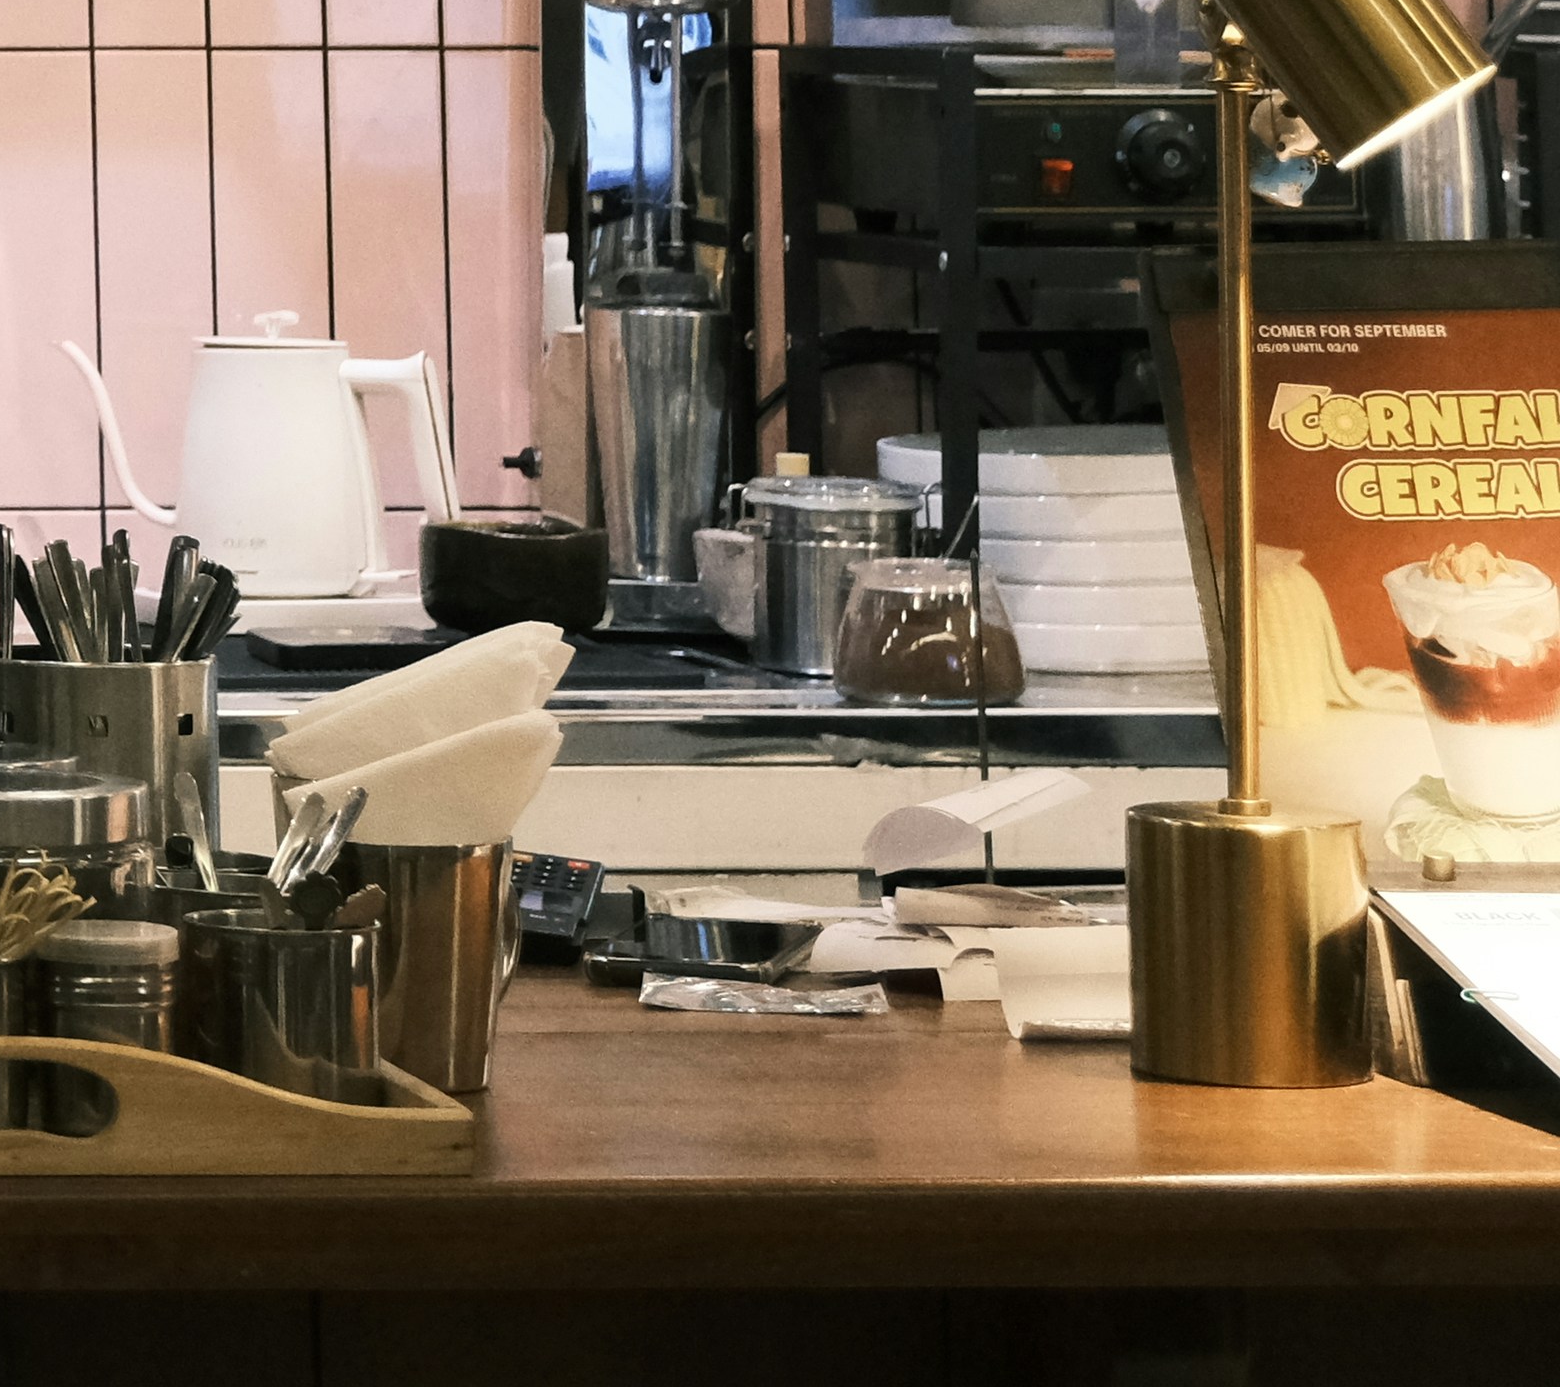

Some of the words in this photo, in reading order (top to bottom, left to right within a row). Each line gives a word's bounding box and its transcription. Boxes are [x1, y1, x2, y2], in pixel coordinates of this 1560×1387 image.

[1319, 324, 1352, 338] FOR
[1353, 324, 1448, 338] SEPTEMBER
[1256, 342, 1290, 353] 05/09
[1292, 342, 1325, 353] UNTIL
[1326, 342, 1359, 353] 03/10
